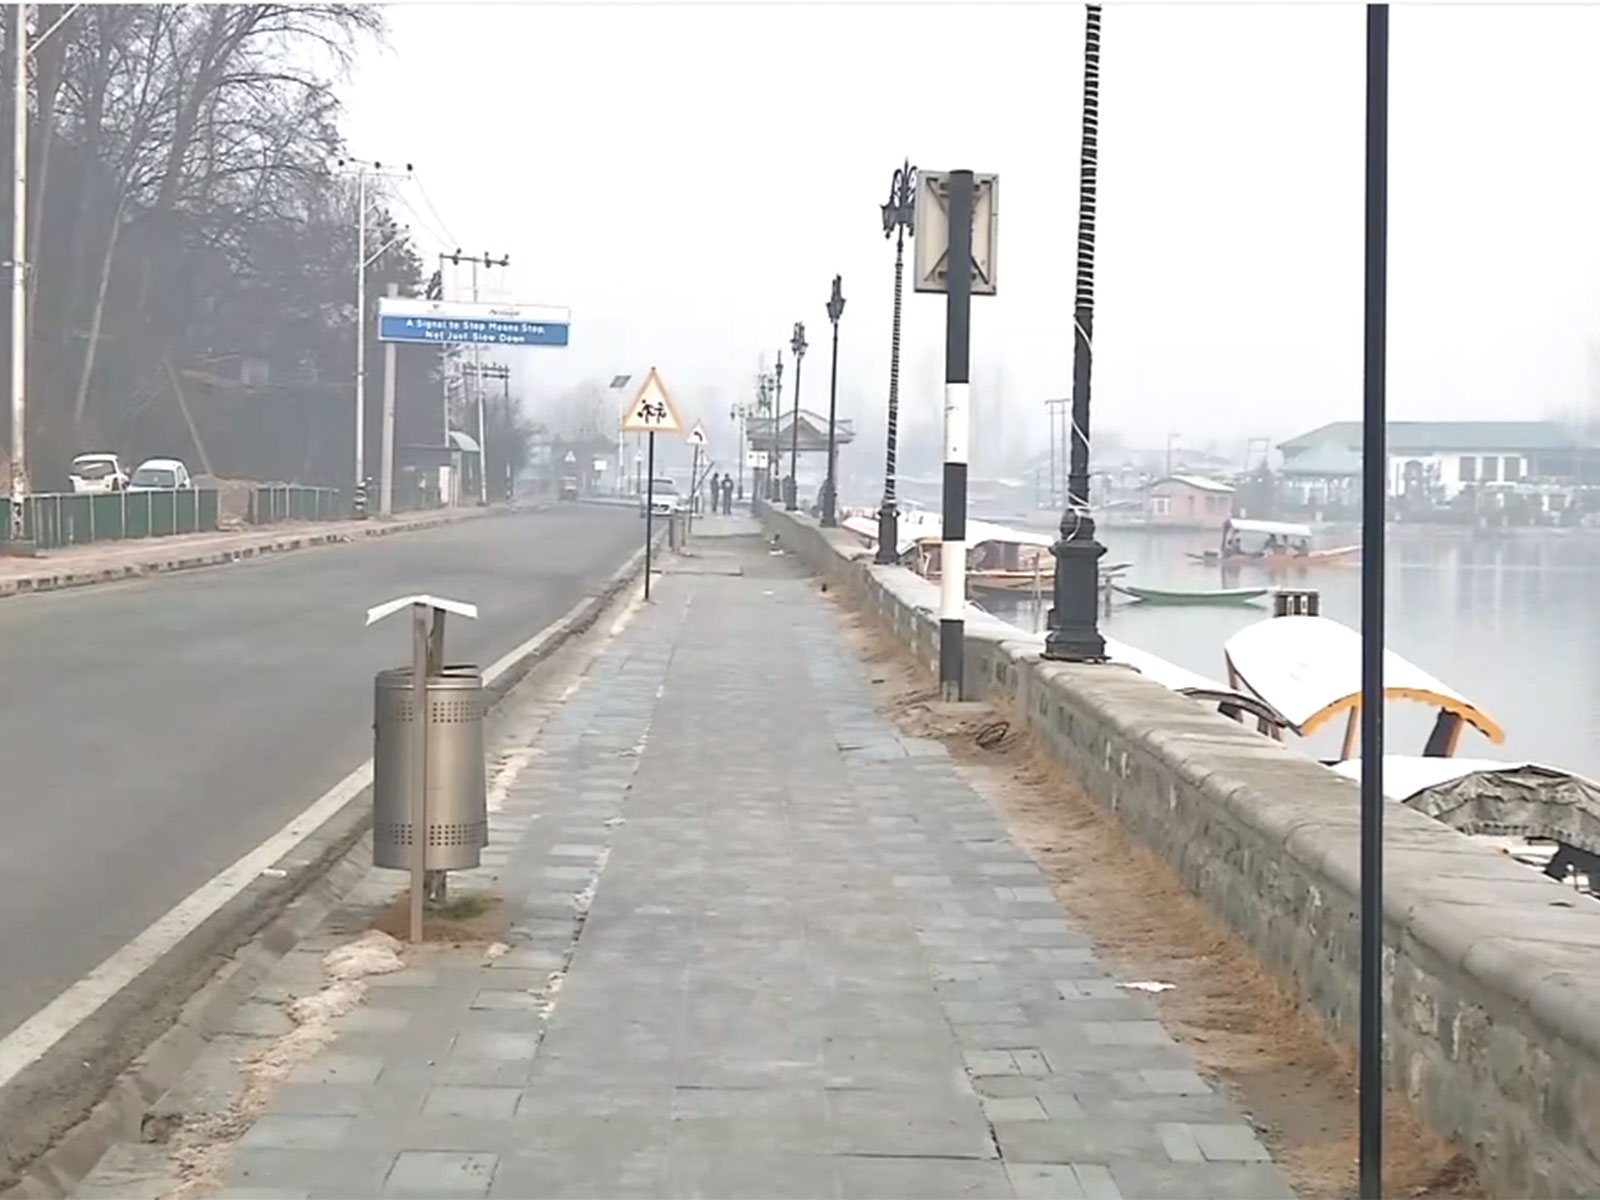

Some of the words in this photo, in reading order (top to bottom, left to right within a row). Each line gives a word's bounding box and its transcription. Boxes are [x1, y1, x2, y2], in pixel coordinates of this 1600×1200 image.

[416, 319, 447, 330] Signal
[449, 320, 461, 330] to
[463, 321, 486, 332] Stop
[488, 322, 519, 332] Means
[425, 330, 445, 340] Not
[447, 331, 469, 341] Just
[473, 331, 496, 342] Slow
[499, 333, 526, 343] Down
